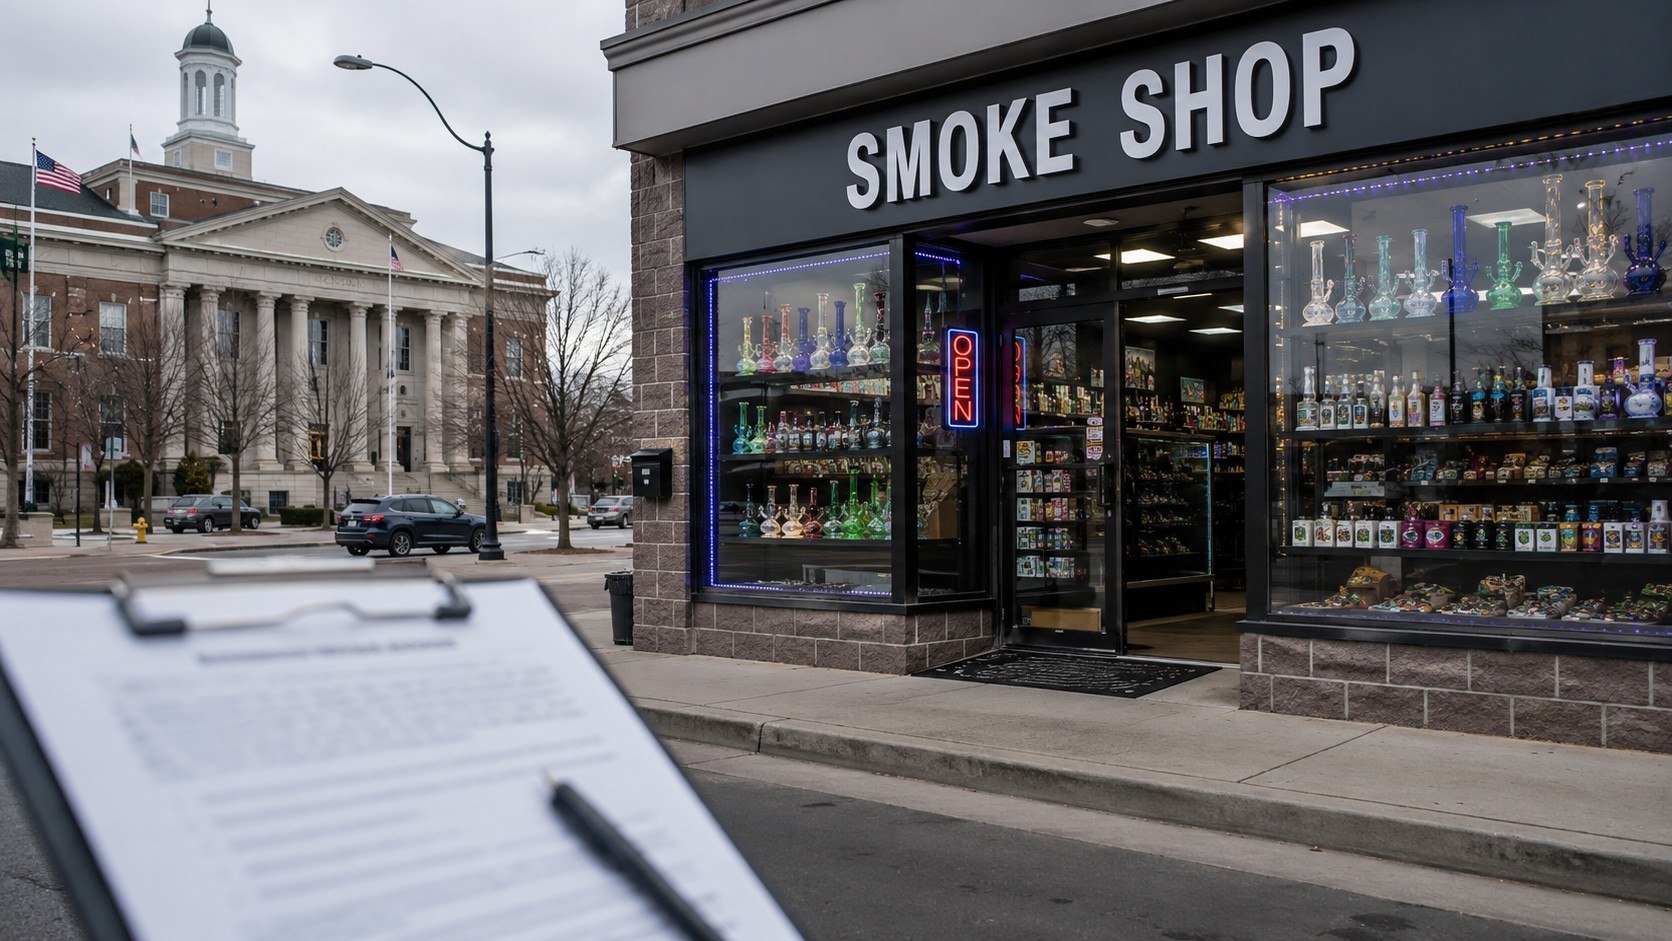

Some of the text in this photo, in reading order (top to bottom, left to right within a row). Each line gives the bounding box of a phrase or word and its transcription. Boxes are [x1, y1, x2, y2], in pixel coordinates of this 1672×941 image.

[846, 26, 1357, 211] SMOKE SHOP
[954, 336, 972, 421] OPEN
